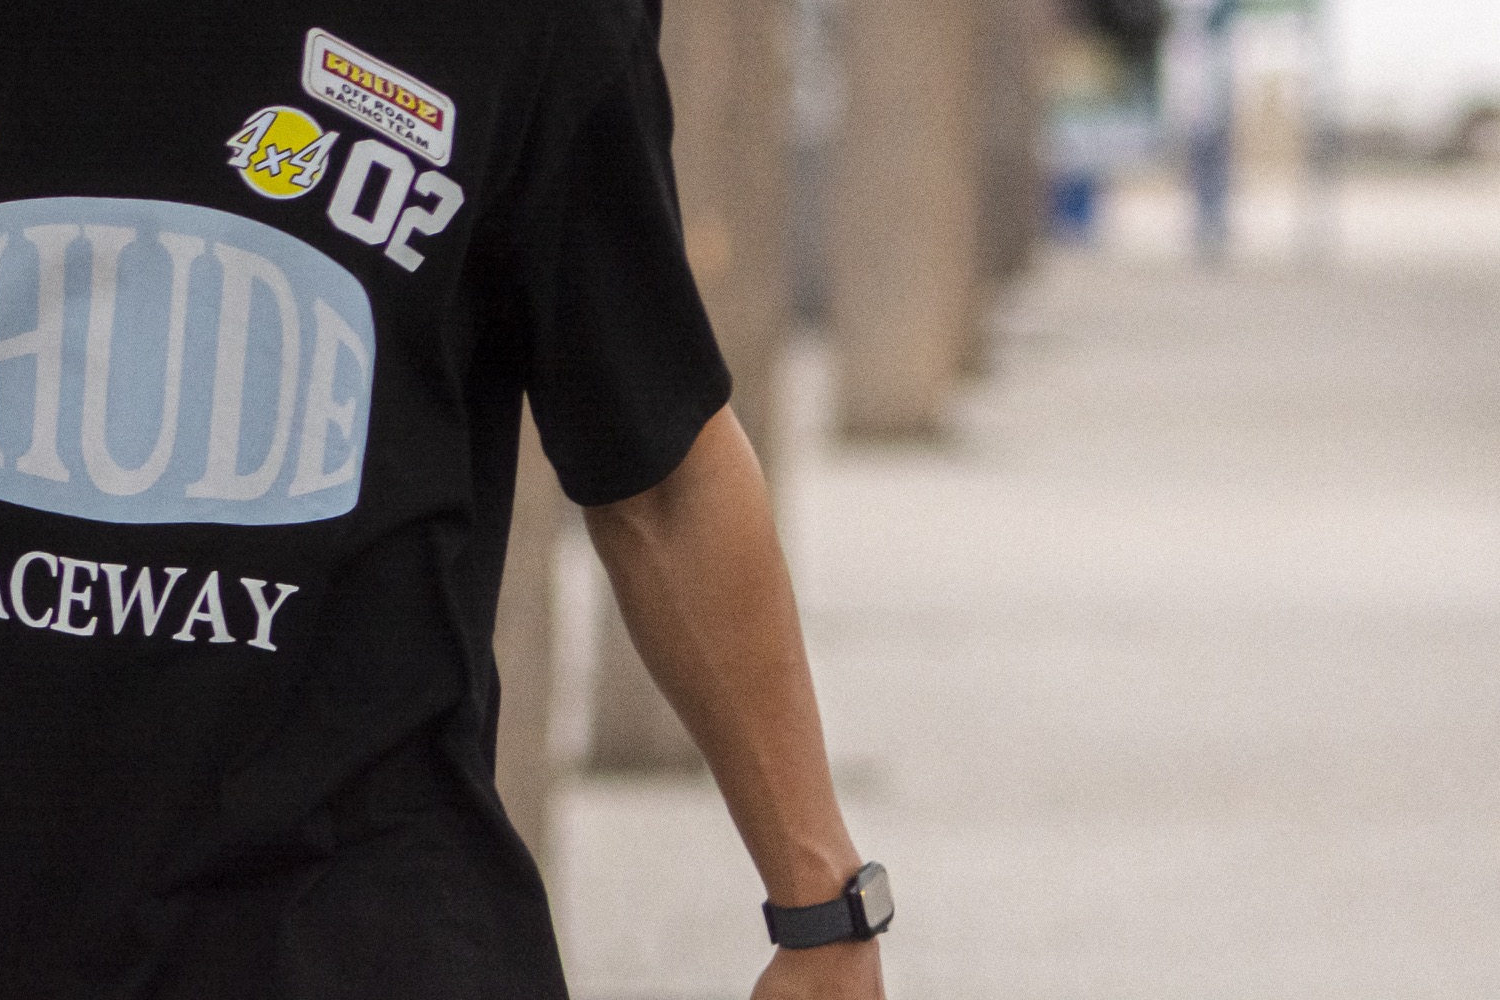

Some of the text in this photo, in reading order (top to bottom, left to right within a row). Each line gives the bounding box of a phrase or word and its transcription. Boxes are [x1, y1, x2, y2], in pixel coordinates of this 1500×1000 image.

[325, 86, 429, 149] RACING TEAM
[341, 83, 415, 129] OFF ROAD
[326, 138, 465, 273] 02
